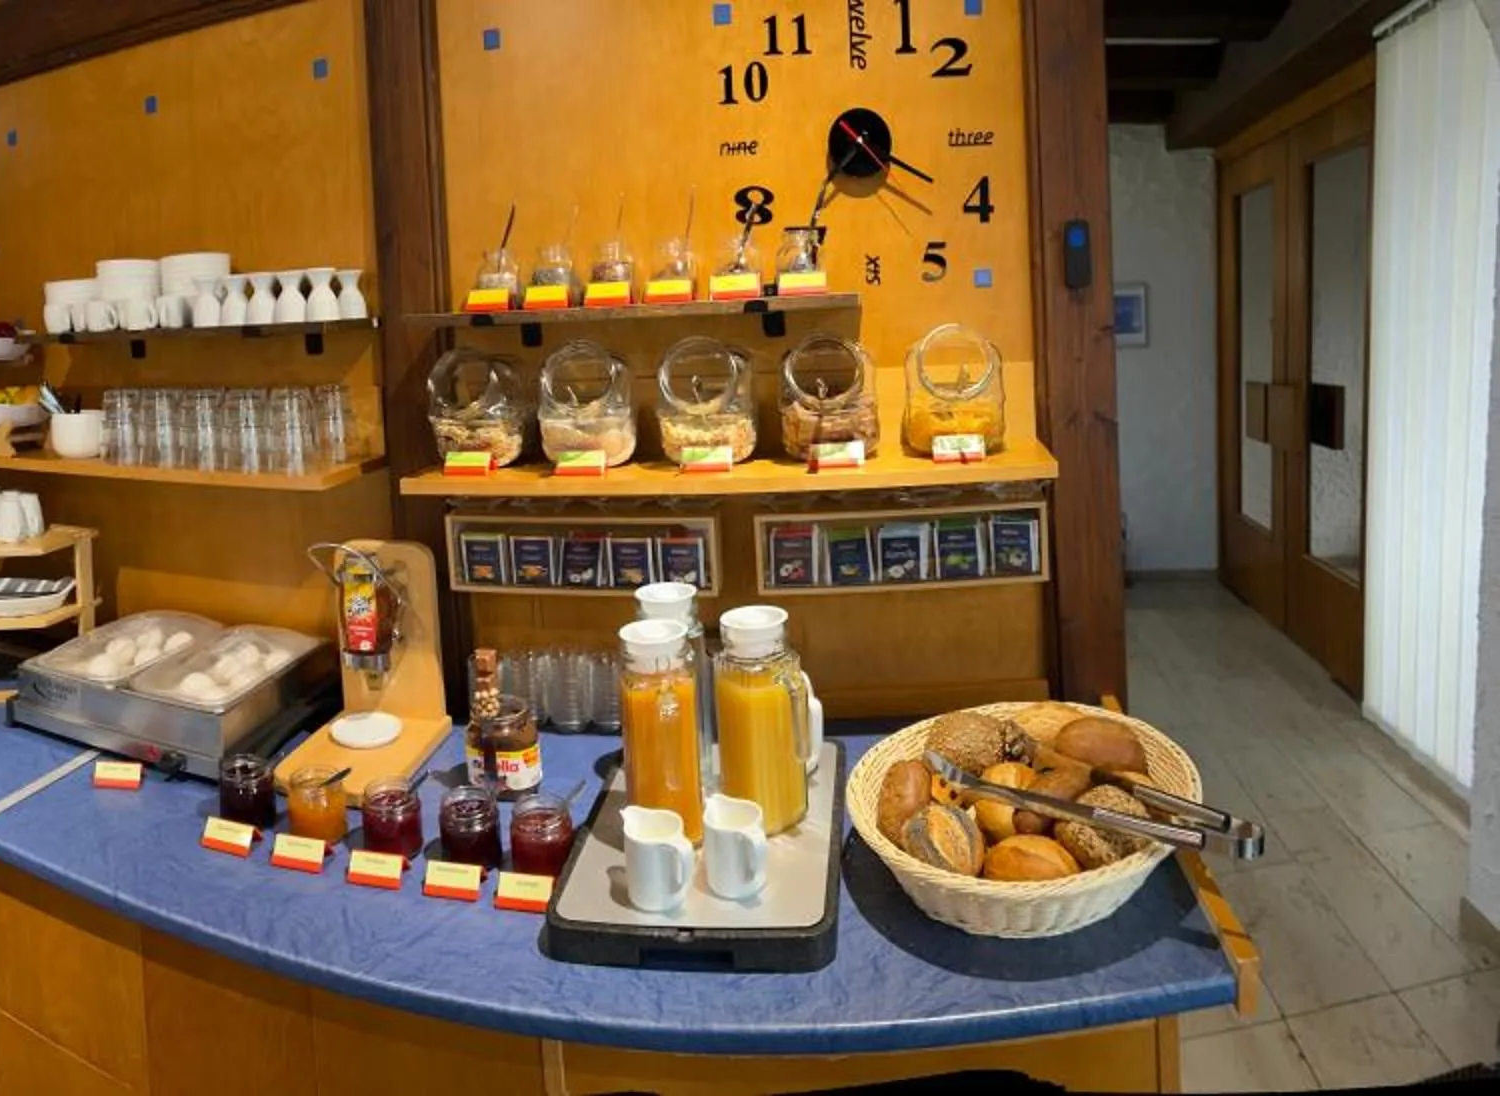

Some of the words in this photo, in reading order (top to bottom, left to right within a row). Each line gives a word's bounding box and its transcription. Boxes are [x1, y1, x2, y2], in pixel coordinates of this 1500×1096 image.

[763, 13, 812, 56] 11
[847, 0, 872, 70] welve
[894, 0, 917, 54] 1
[930, 37, 973, 78] 2
[718, 61, 769, 105] 10
[719, 140, 758, 156] nine
[948, 128, 995, 147] three
[734, 186, 775, 225] 8
[963, 176, 995, 223] 4
[865, 253, 881, 286] six
[921, 241, 947, 282] 5
